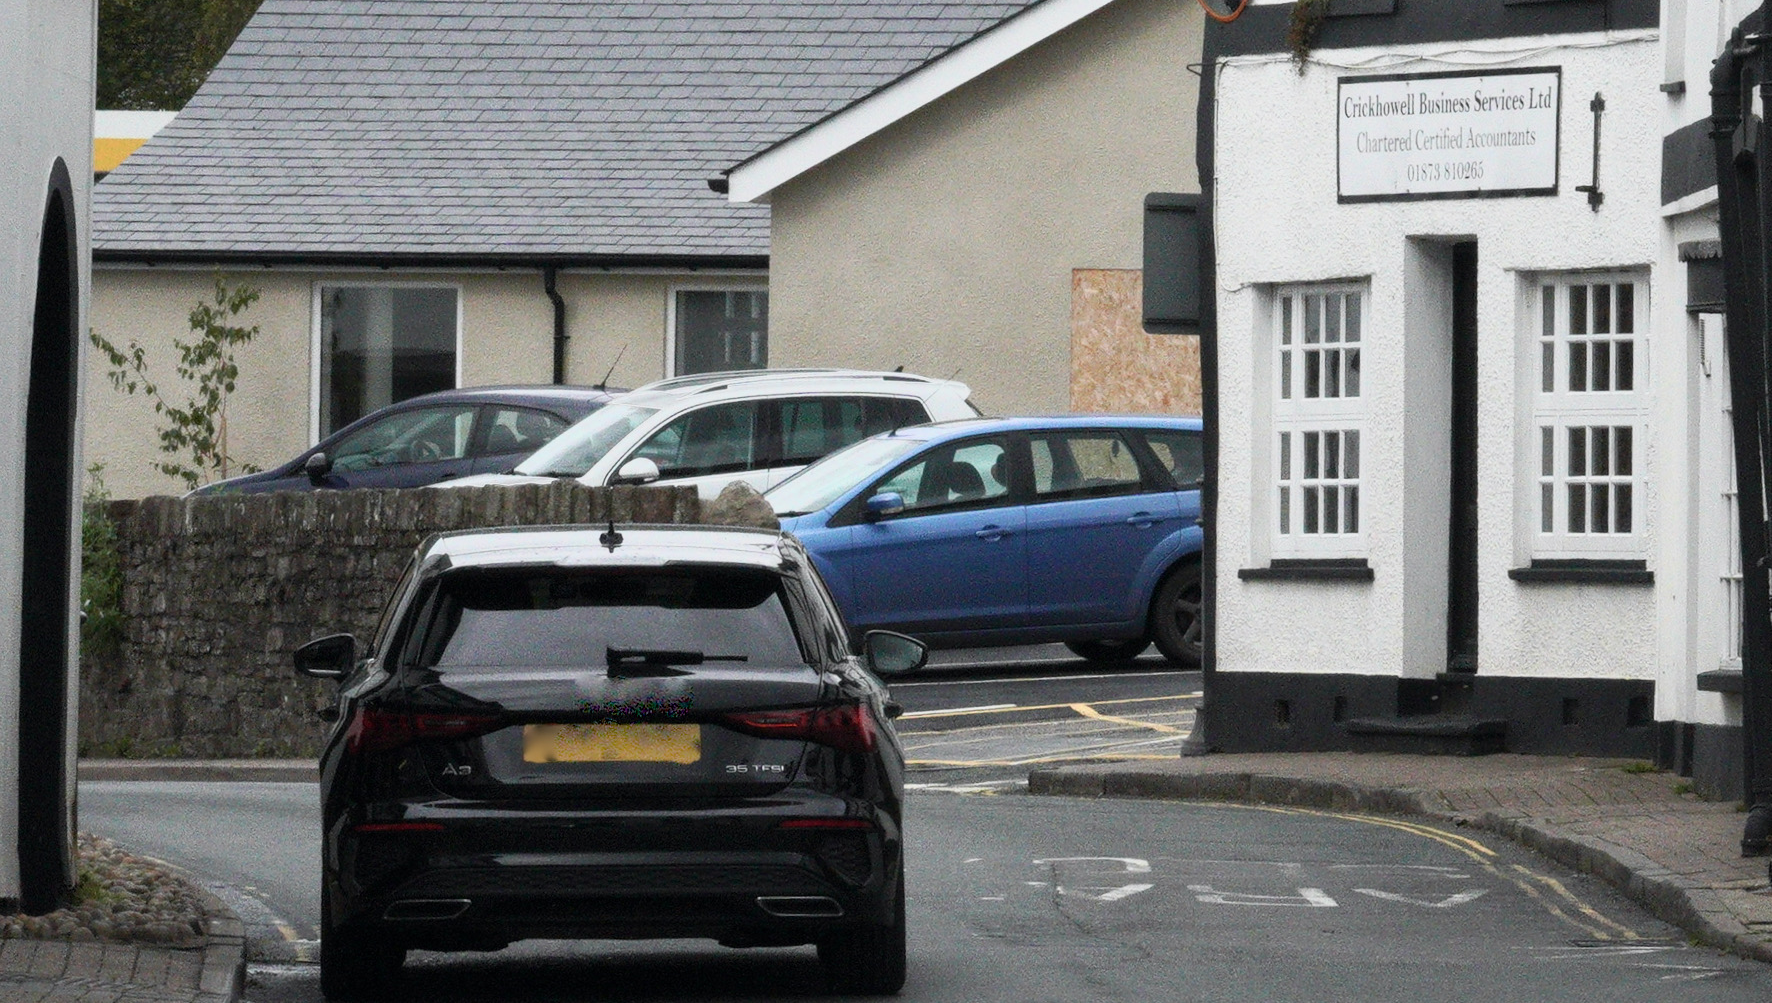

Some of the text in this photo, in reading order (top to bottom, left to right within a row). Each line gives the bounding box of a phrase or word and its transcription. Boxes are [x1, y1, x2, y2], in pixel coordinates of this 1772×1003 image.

[1344, 86, 1552, 118] Crickhowell Business Services Ltd
[1356, 127, 1536, 153] Chartered Certified Accountants
[1407, 161, 1484, 181] 01873 810265
[442, 762, 472, 776] A3
[725, 764, 785, 773] 35 TFSI
